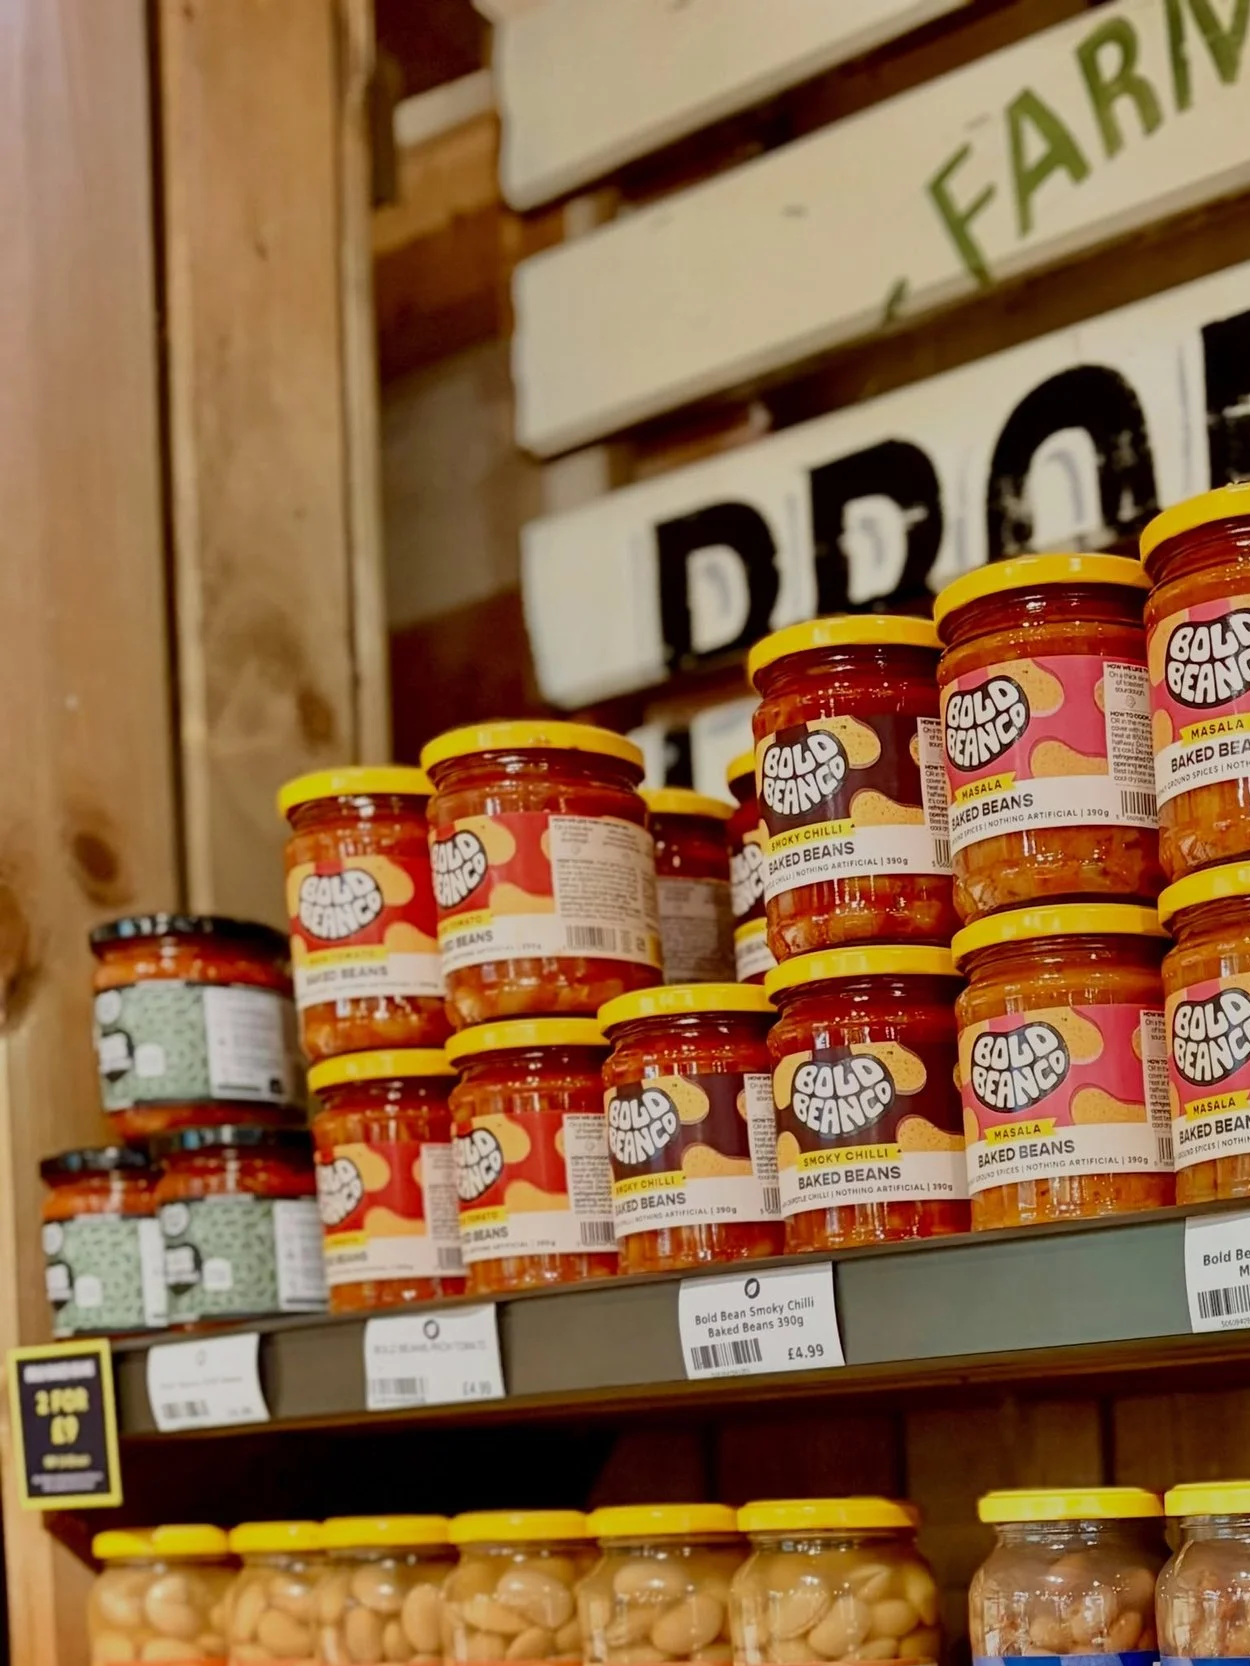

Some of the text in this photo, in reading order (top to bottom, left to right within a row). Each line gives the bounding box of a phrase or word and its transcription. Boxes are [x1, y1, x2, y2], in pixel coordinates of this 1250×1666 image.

[946, 679, 1020, 729] BOLD
[1190, 719, 1245, 740] MASALA
[764, 734, 839, 779] BOLD
[1170, 746, 1215, 774] BAKED
[961, 778, 1003, 801] MASALA
[981, 793, 1034, 817] BEANS
[770, 825, 843, 852] SMOKY CHILLI
[803, 841, 855, 863] BEANS
[794, 1057, 885, 1099] BOLD
[1192, 1096, 1236, 1115] MASALA
[803, 1149, 889, 1168] SMOKY CHILLI
[1203, 1249, 1232, 1267] Bold
[695, 1296, 815, 1326] Bold Bean Smoky Chilli
[708, 1315, 804, 1338] Baked Beans 390g
[787, 1343, 825, 1361] £4.99
